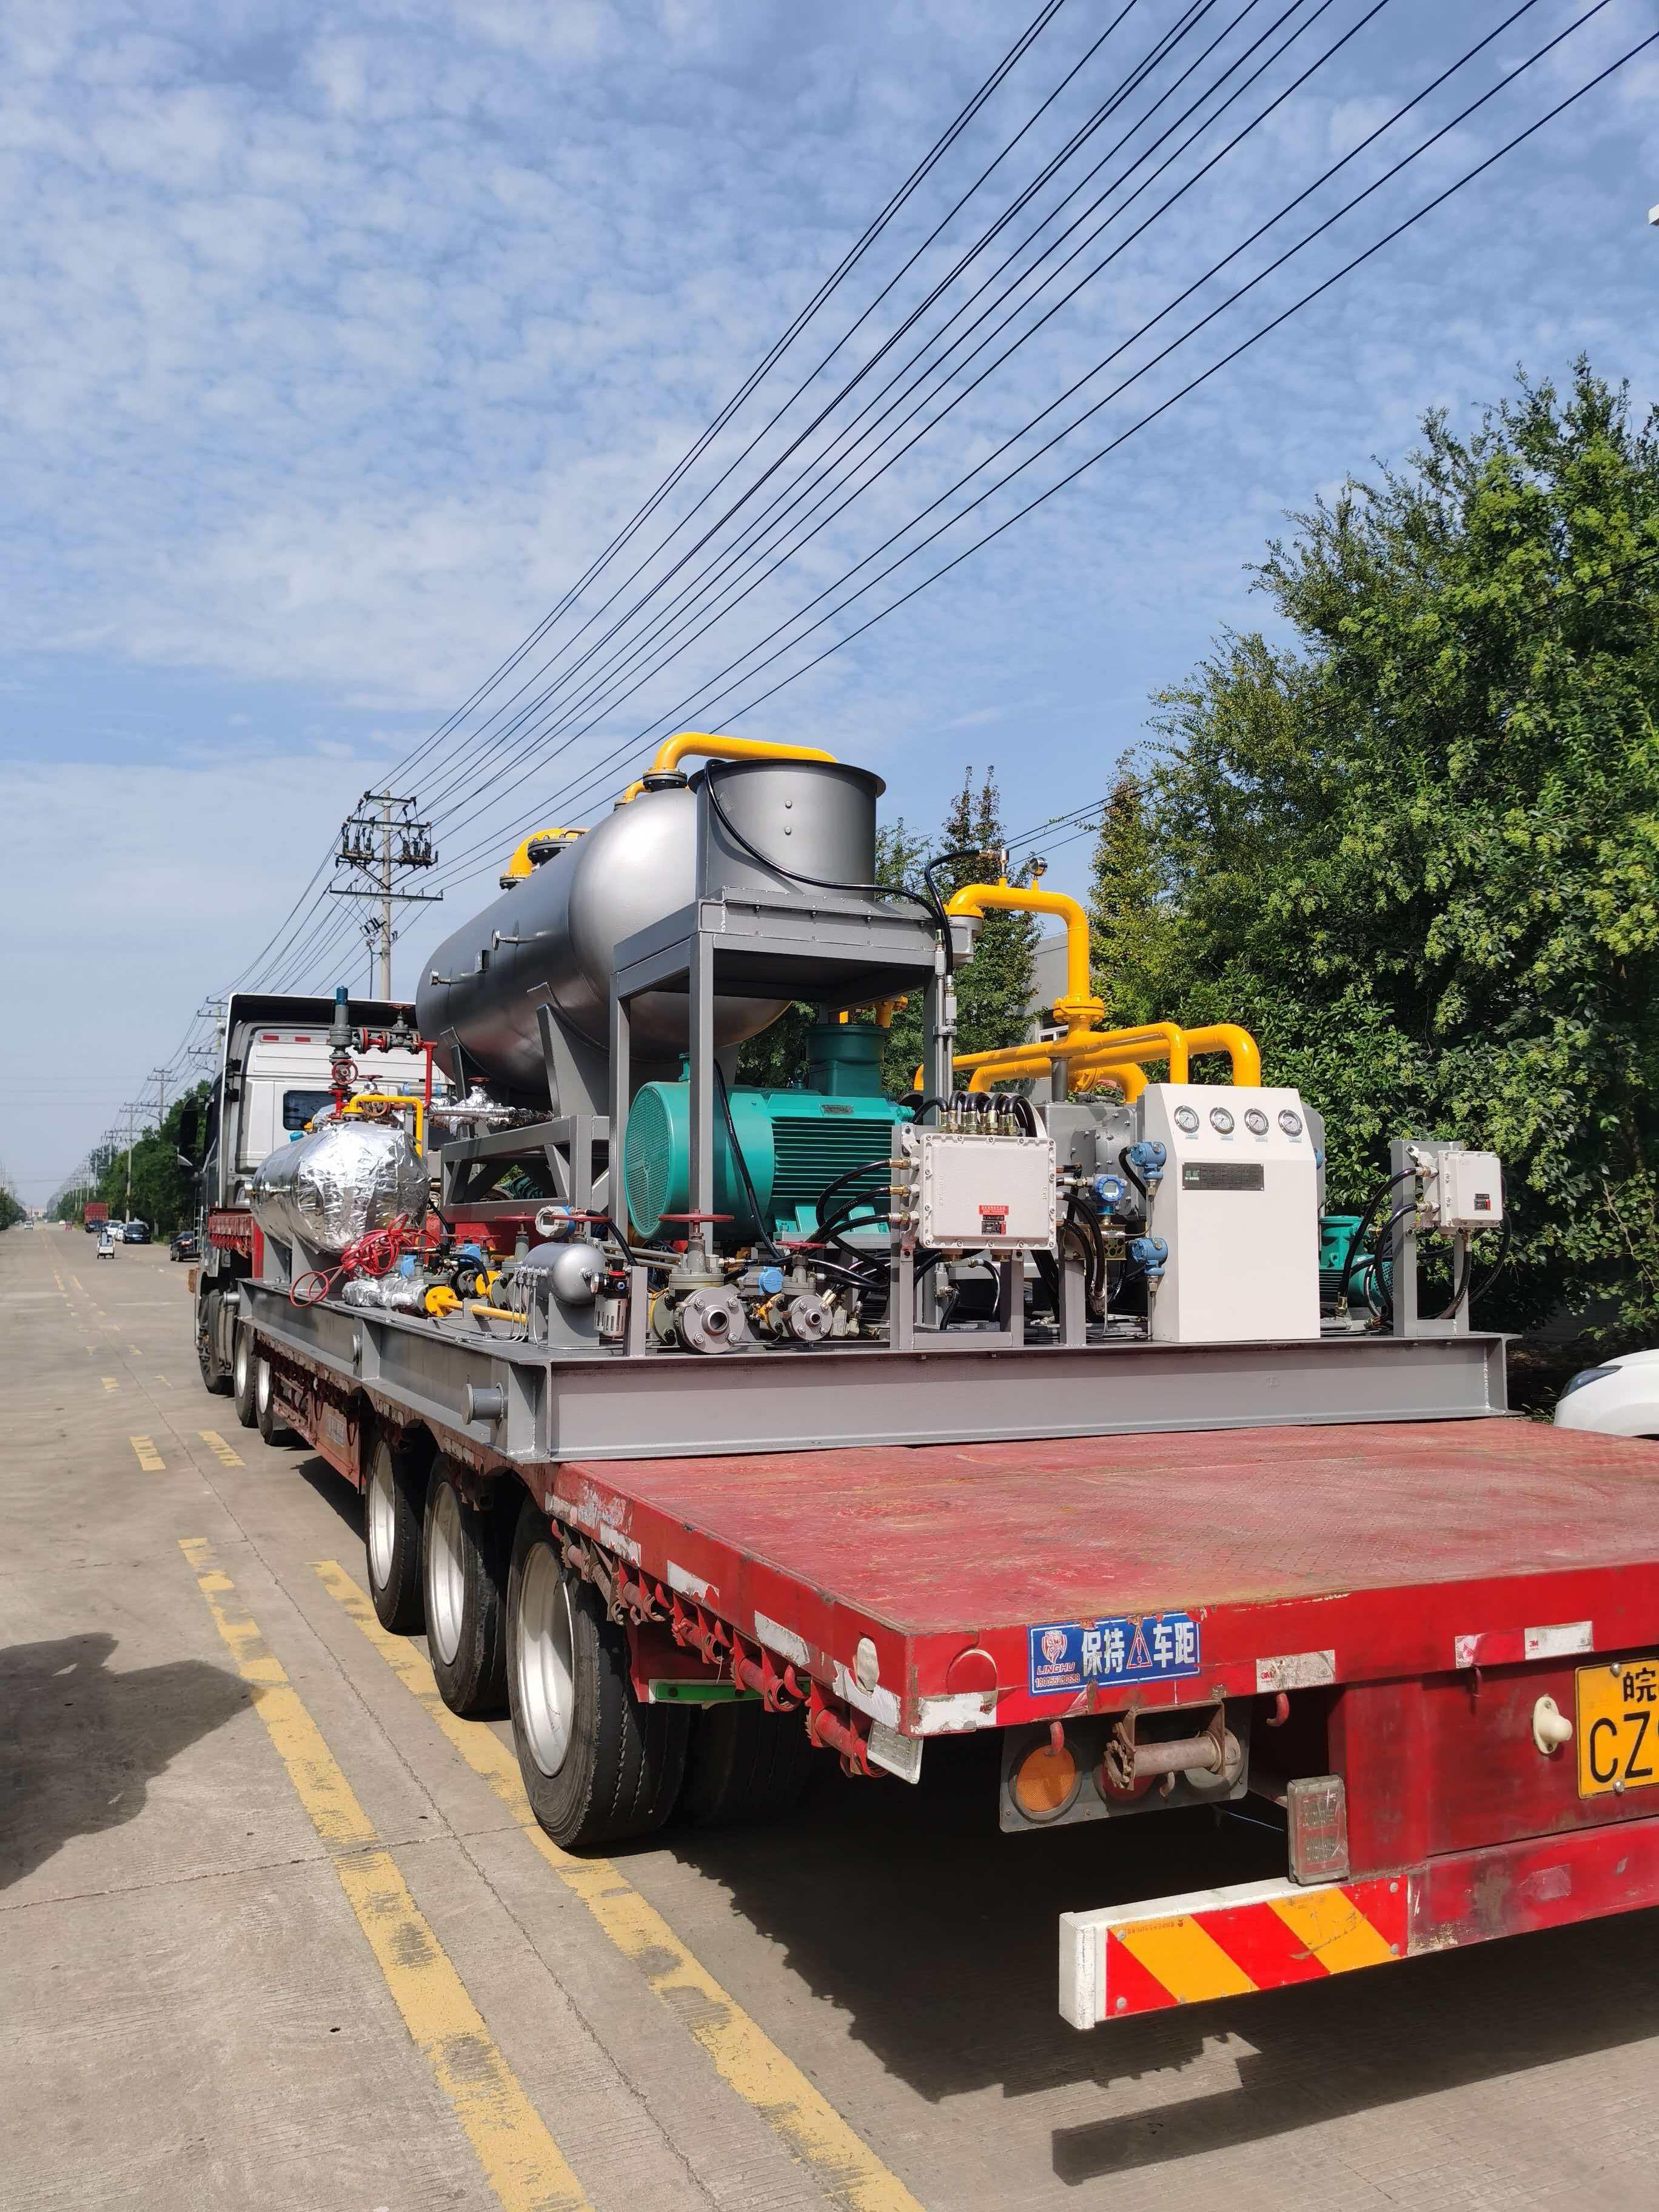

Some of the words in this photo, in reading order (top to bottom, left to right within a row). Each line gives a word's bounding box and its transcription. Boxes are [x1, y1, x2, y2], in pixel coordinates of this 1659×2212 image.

[1037, 1662, 1076, 1675] LINGHU
[1082, 1627, 1125, 1677] 保持
[1153, 1621, 1195, 1668] 车距
[1590, 1711, 1659, 1783] CZ
